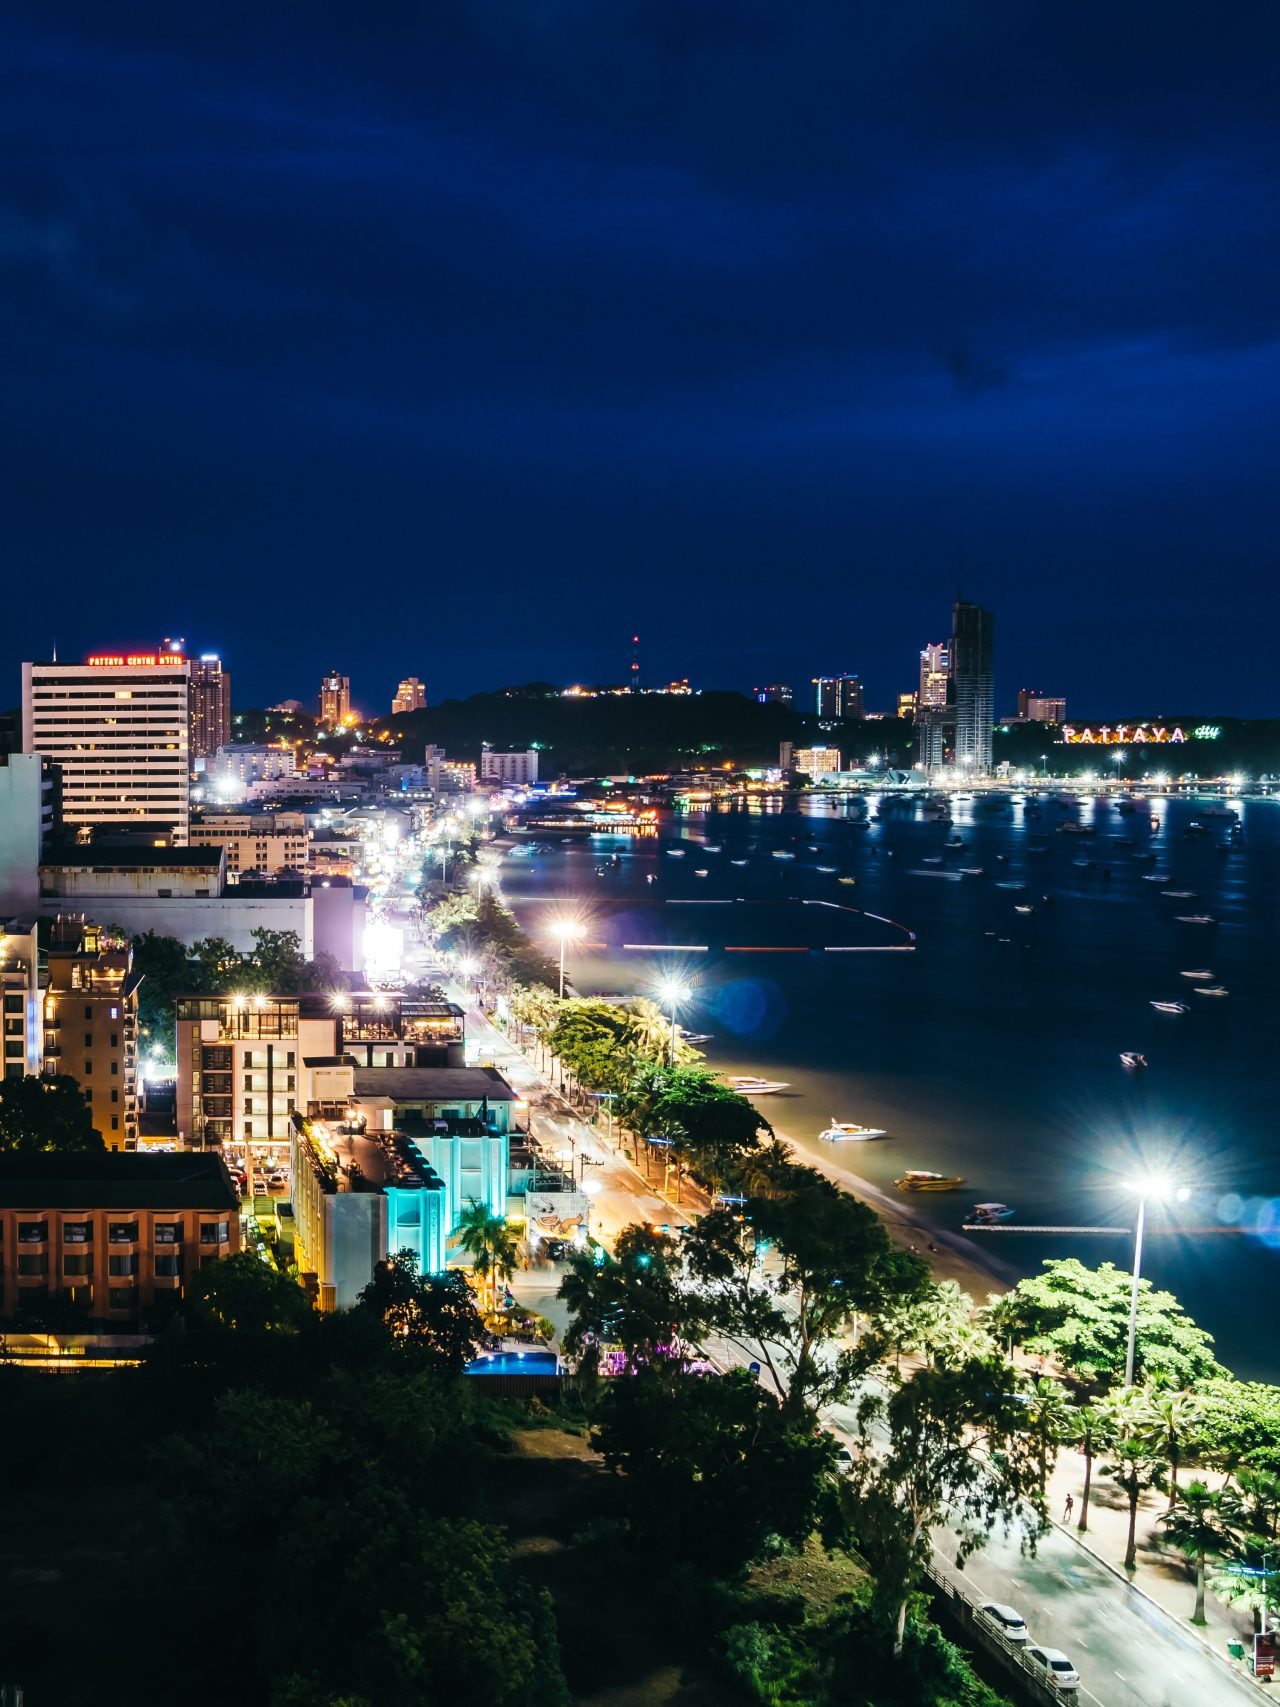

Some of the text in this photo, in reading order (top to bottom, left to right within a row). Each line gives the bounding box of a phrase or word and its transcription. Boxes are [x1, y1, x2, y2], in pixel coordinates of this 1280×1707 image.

[89, 656, 124, 666] PATTAYA
[127, 656, 156, 666] CENTRE
[1063, 727, 1185, 743] PATTAYA
